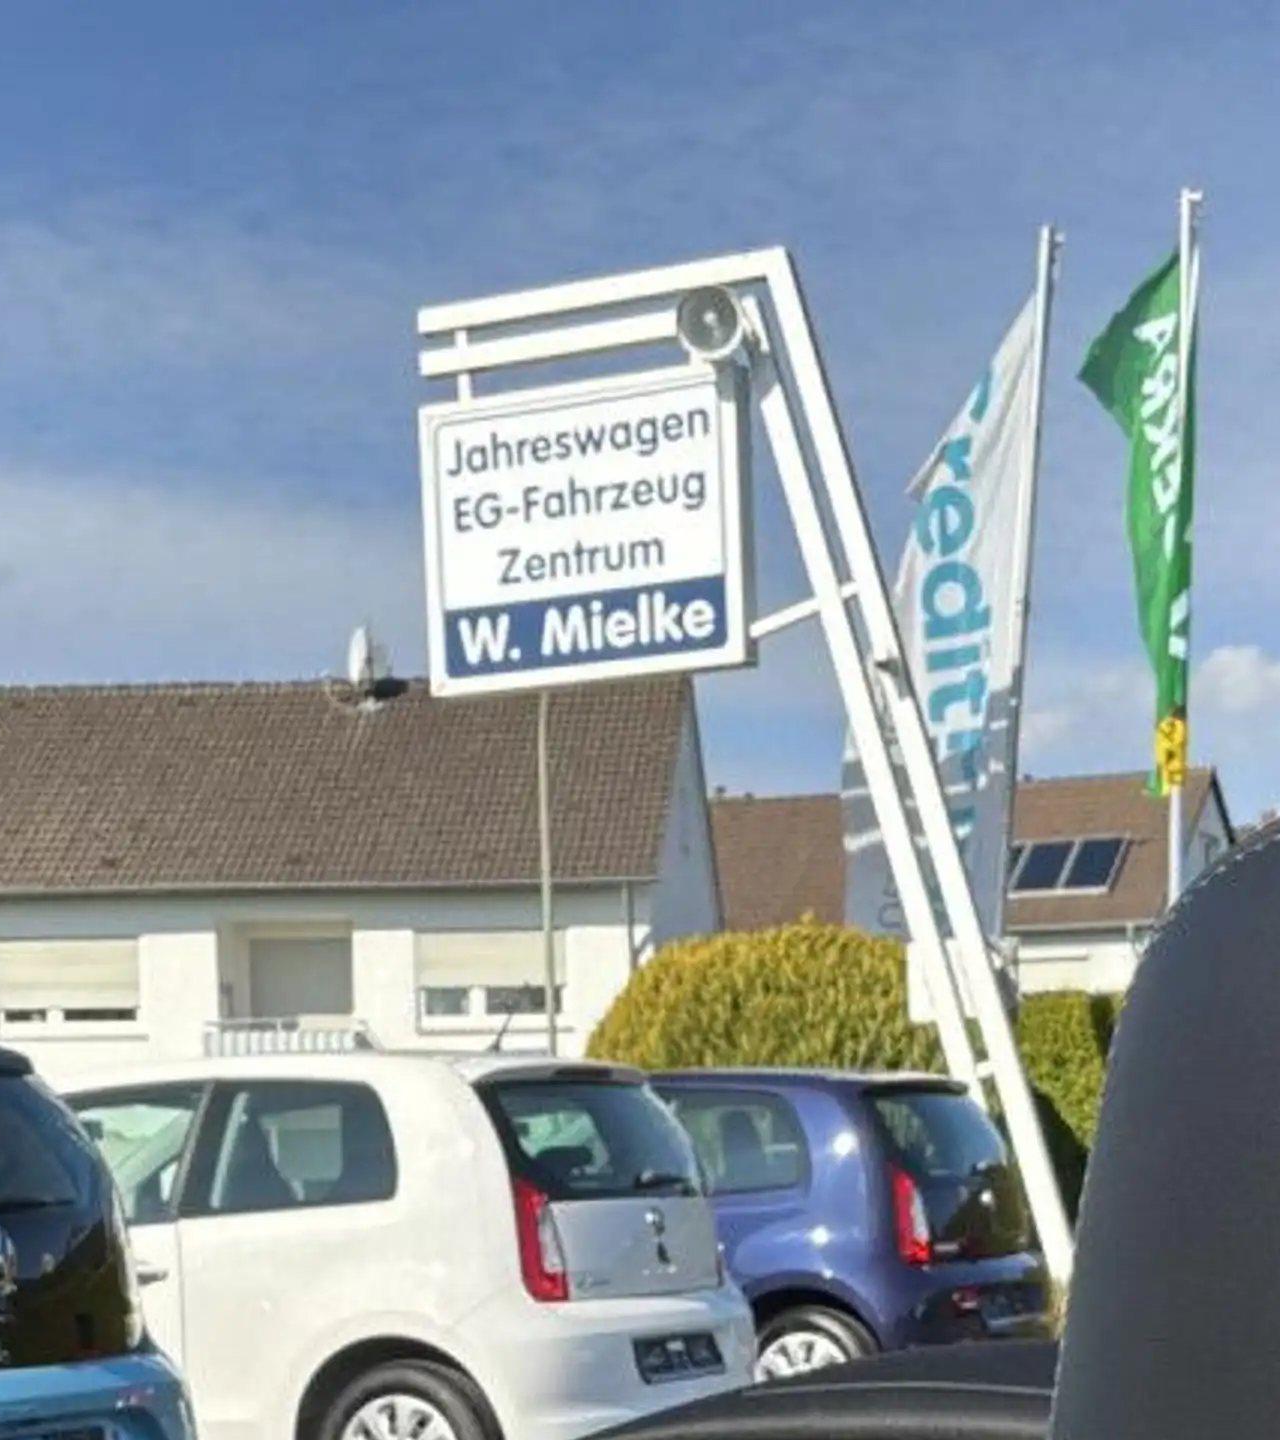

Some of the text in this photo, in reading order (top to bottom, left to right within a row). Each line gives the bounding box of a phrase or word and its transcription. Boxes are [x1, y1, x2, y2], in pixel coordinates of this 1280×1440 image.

[446, 407, 711, 478] Jahreswagen
[452, 470, 707, 533] EG-Fahrzeug
[497, 536, 666, 585] Zentrum
[458, 590, 717, 665] W. Mielke
